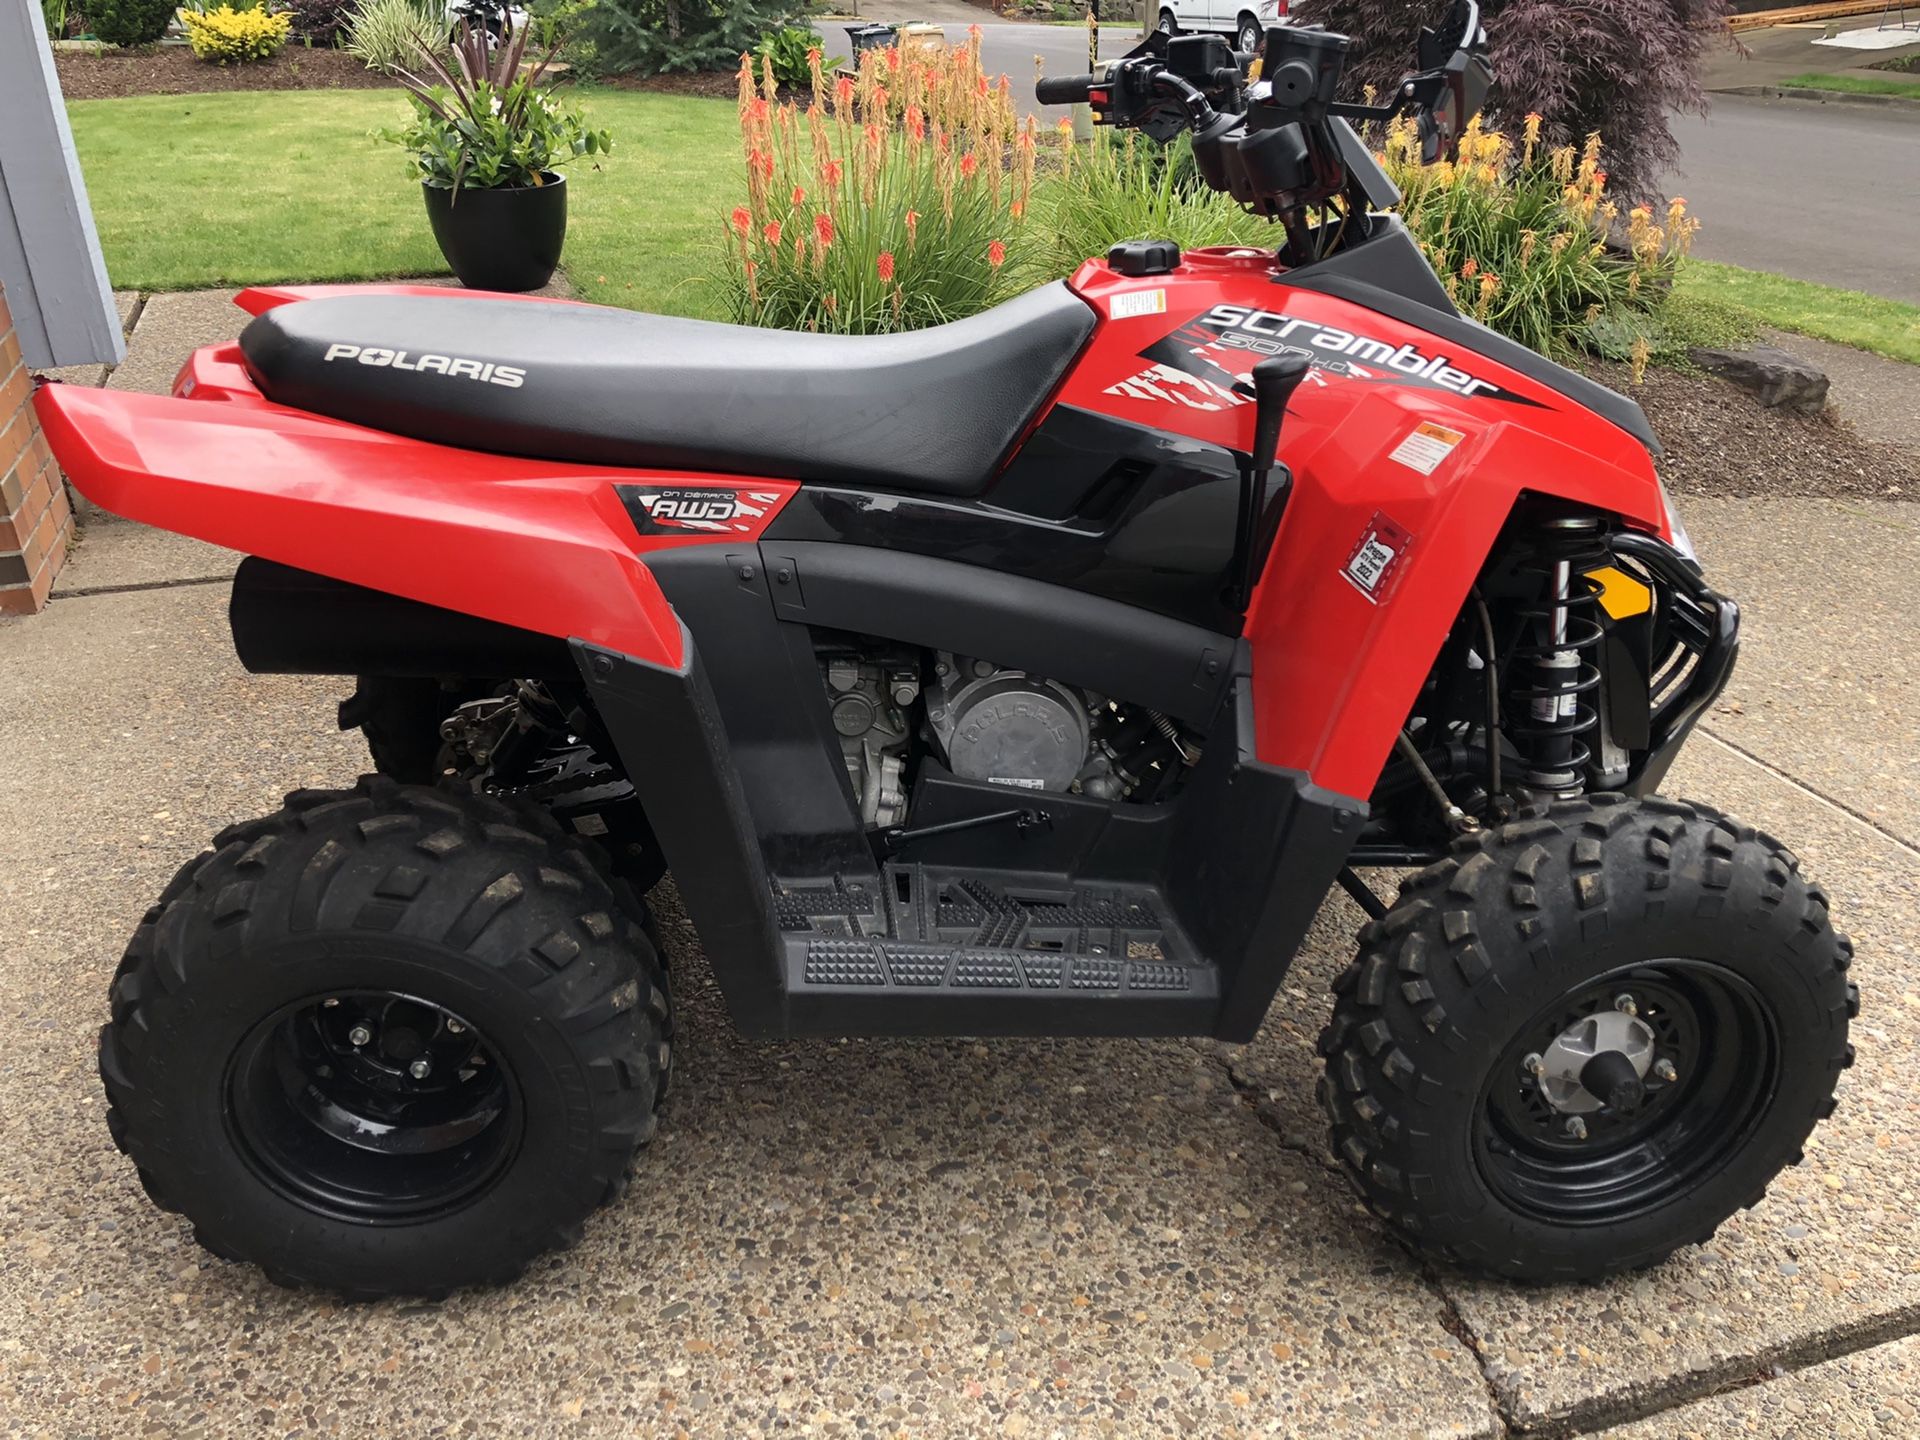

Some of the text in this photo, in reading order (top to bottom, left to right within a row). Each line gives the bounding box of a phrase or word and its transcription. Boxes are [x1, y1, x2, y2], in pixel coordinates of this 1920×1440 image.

[324, 343, 527, 389] POLARIS
[651, 500, 734, 520] AWD
[1356, 562, 1374, 581] 2022
